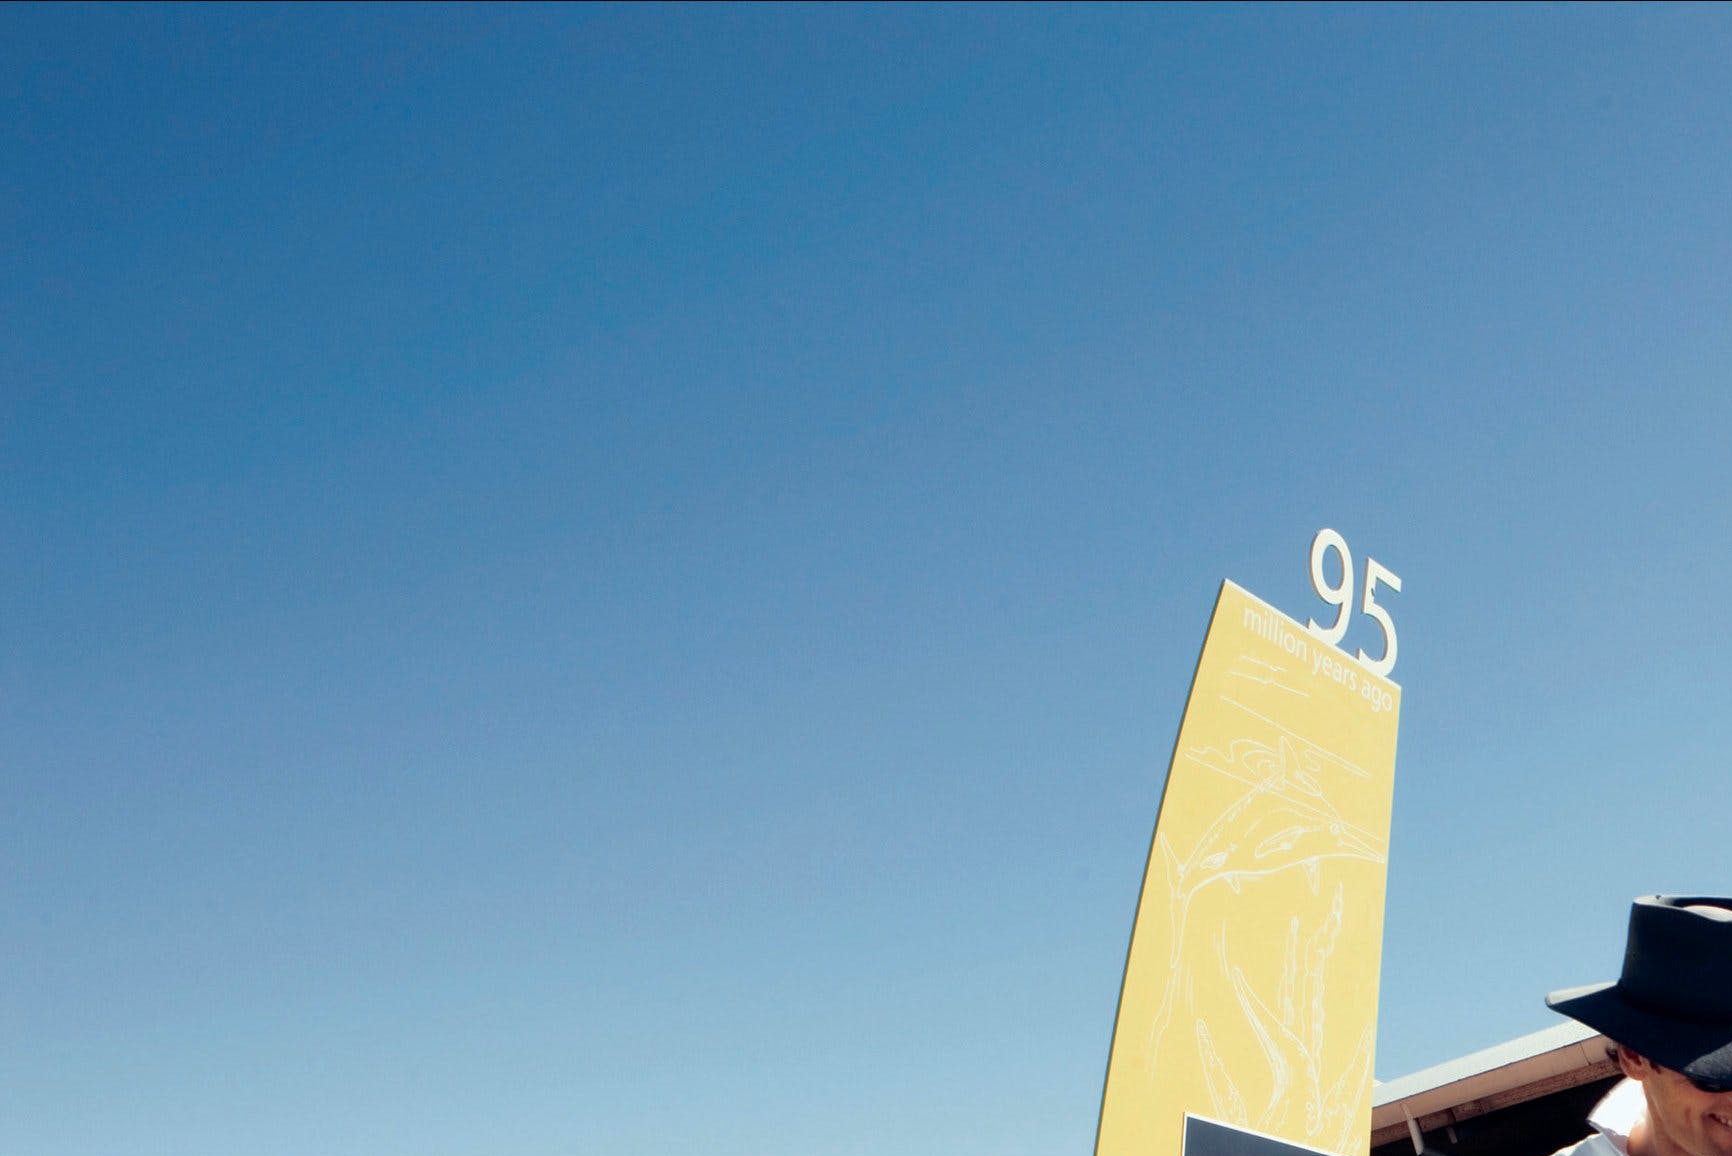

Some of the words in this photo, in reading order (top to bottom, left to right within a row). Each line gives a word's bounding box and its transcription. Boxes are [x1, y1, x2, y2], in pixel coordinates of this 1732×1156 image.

[1243, 607, 1308, 664] million
[1312, 648, 1358, 692] years
[1361, 680, 1393, 713] ago
[1307, 528, 1402, 677] 95
